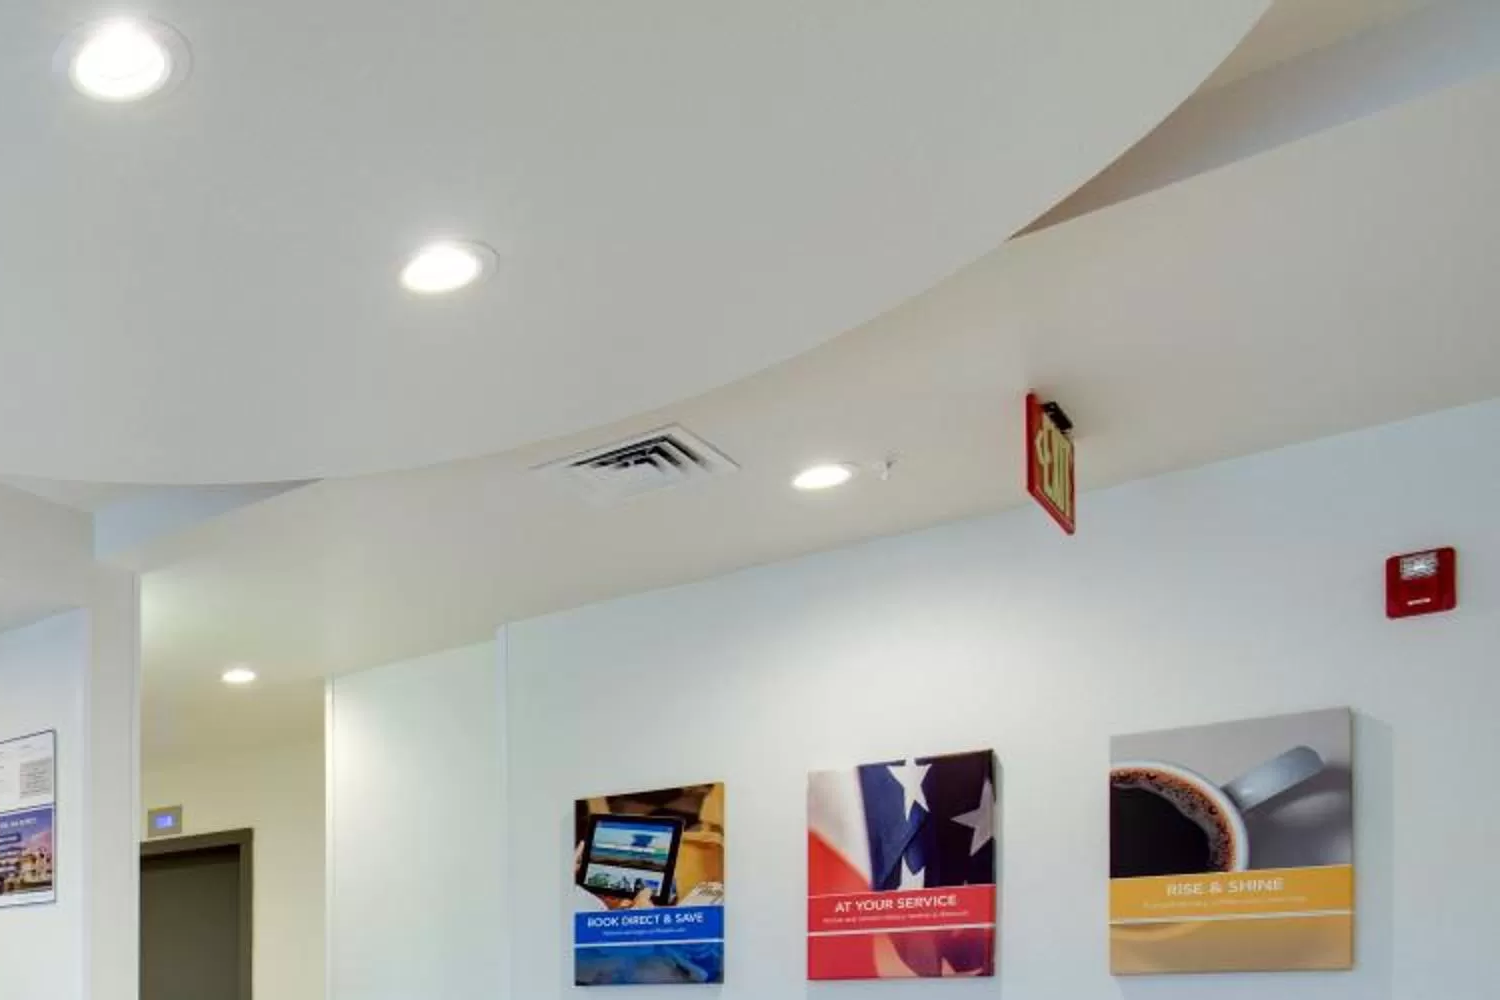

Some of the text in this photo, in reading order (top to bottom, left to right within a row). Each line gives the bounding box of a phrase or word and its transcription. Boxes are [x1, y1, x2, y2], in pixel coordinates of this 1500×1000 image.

[1166, 877, 1285, 897] RISE & SHINE
[835, 894, 958, 913] AT YOUR SERVICE
[587, 916, 619, 928] BOOK
[621, 914, 661, 927] DIRECT
[675, 911, 705, 924] SAVE
